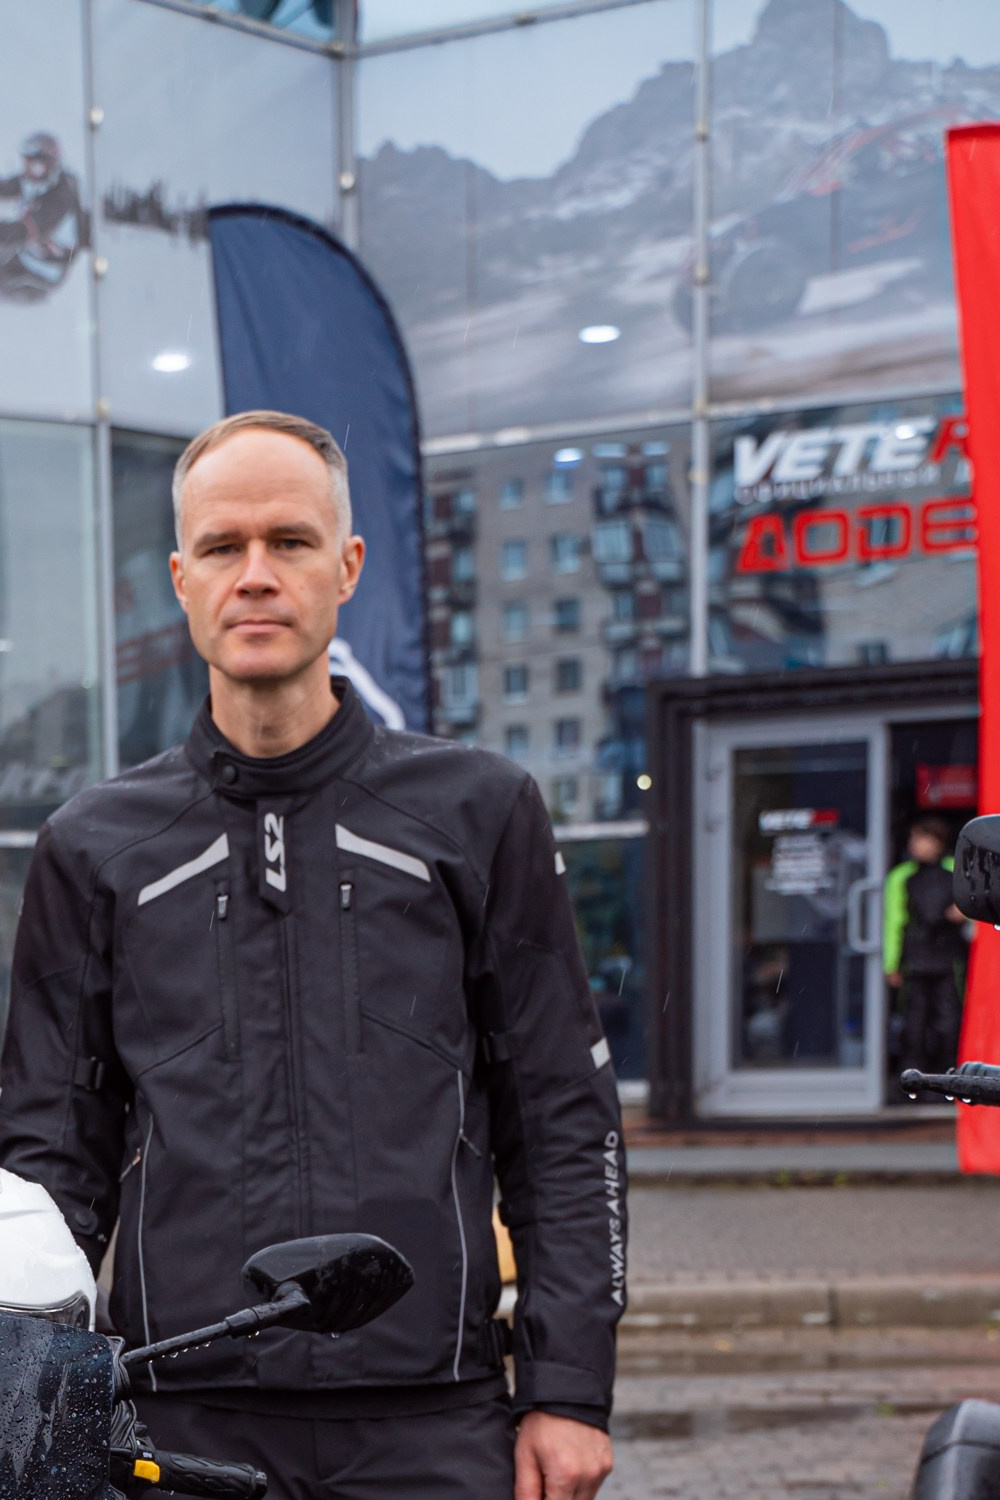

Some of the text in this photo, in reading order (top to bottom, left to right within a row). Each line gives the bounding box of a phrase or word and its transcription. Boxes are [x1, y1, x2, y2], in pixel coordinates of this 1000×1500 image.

[264, 812, 287, 893] LS2
[603, 1130, 625, 1306] ALWAYS AHEAD
